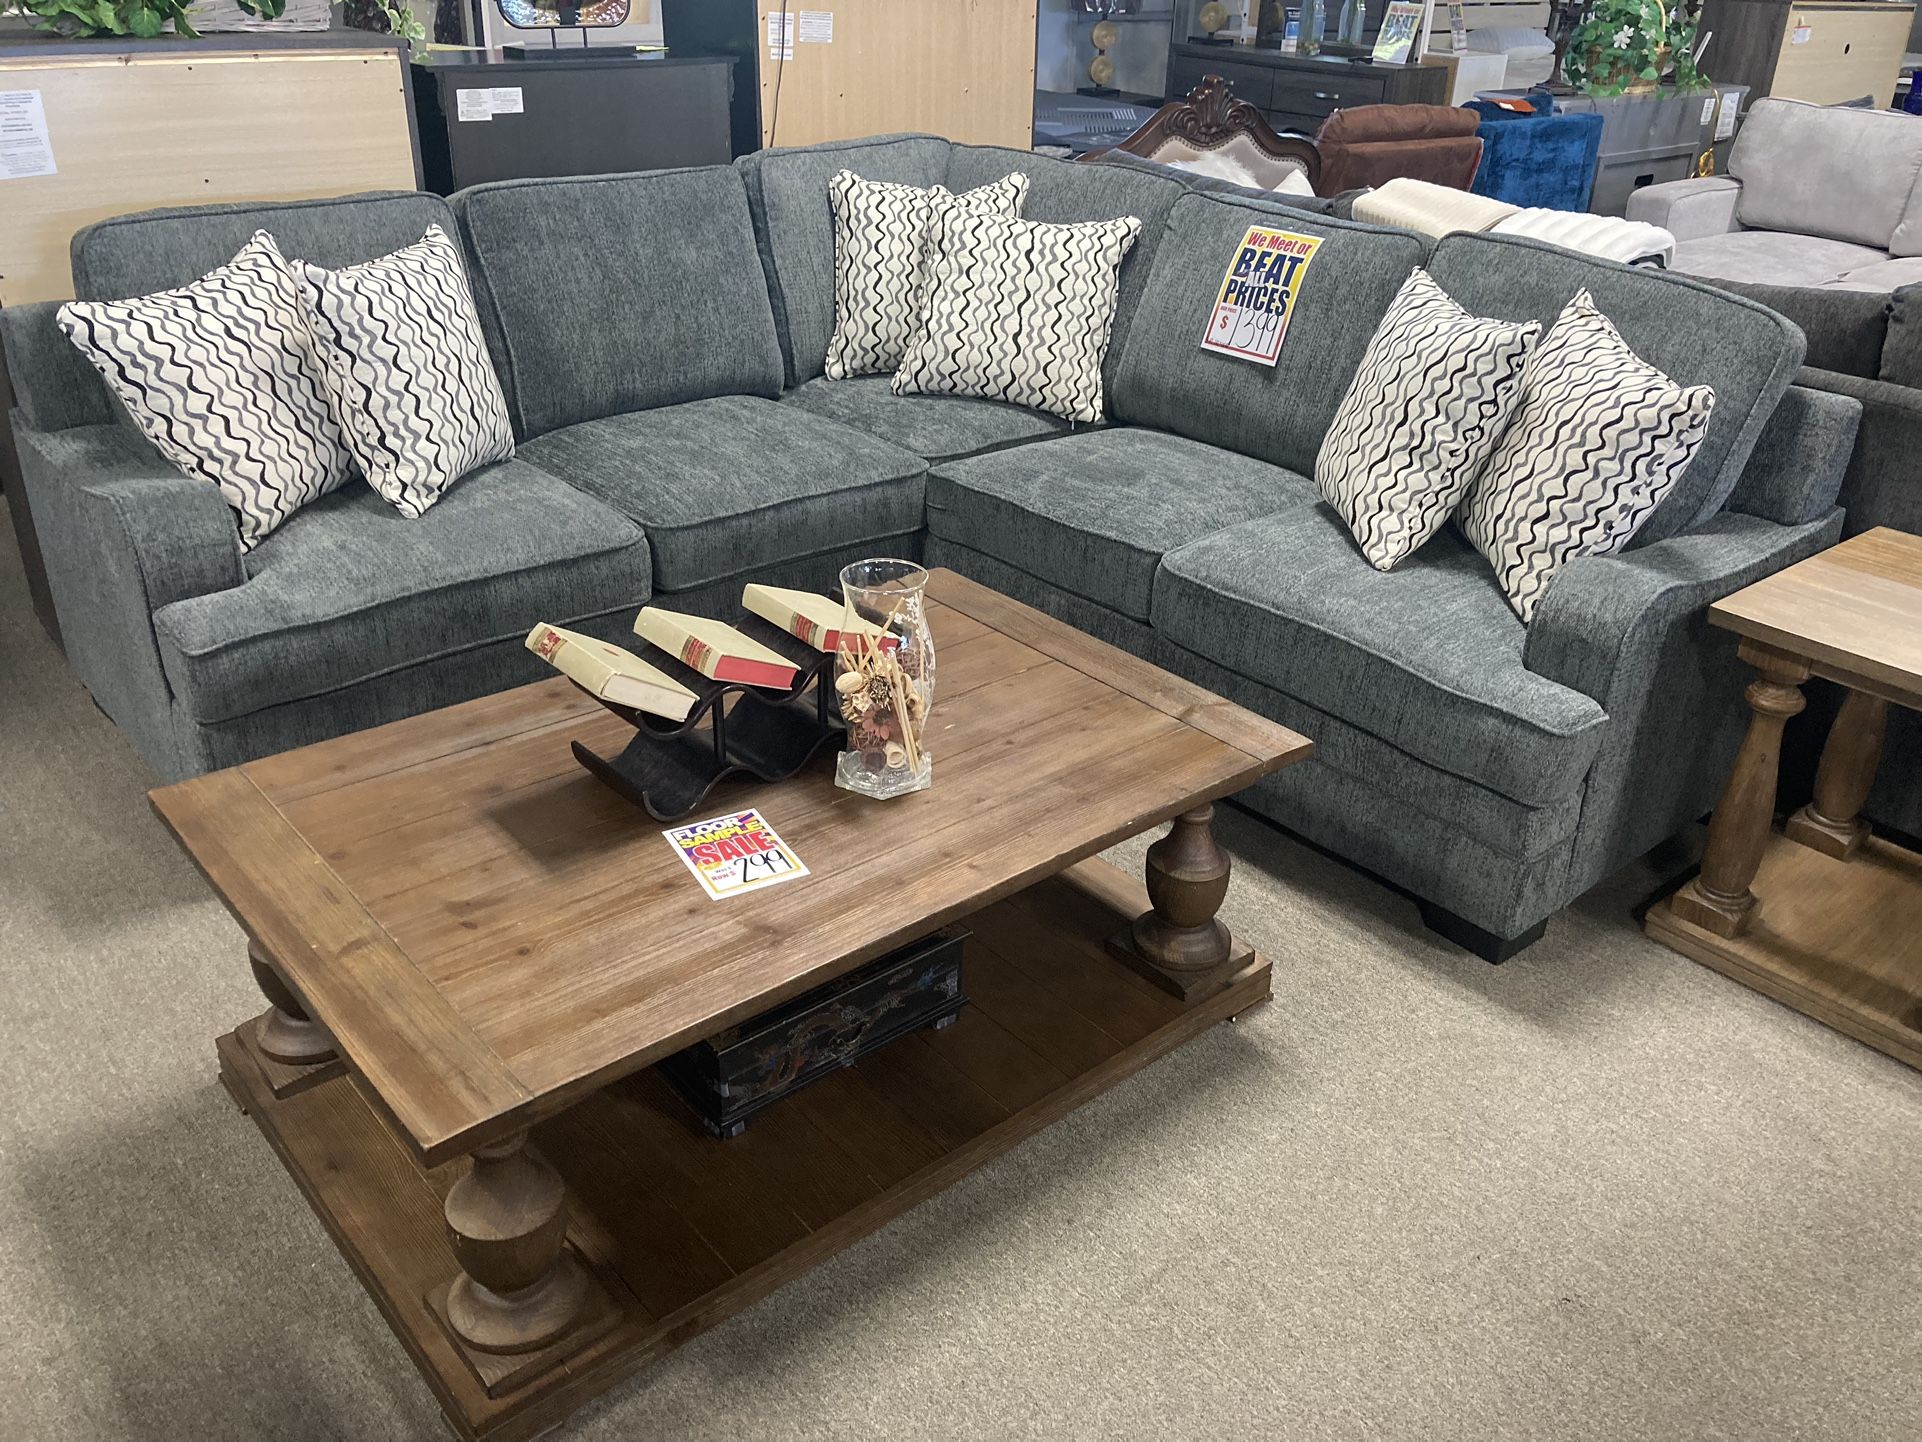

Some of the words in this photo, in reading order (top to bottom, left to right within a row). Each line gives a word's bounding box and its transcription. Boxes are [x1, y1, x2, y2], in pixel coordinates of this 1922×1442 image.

[1247, 231, 1266, 247] We
[1267, 235, 1298, 252] Meet
[1297, 243, 1313, 255] or
[1232, 247, 1304, 287] BEAT
[1245, 271, 1266, 287] ALL
[1223, 279, 1291, 316] PRICES
[1228, 308, 1279, 354] 1399
[671, 817, 743, 841] FLOOR
[679, 820, 762, 848] SAMPLE
[693, 831, 776, 865] SALE
[733, 849, 793, 883] 299
